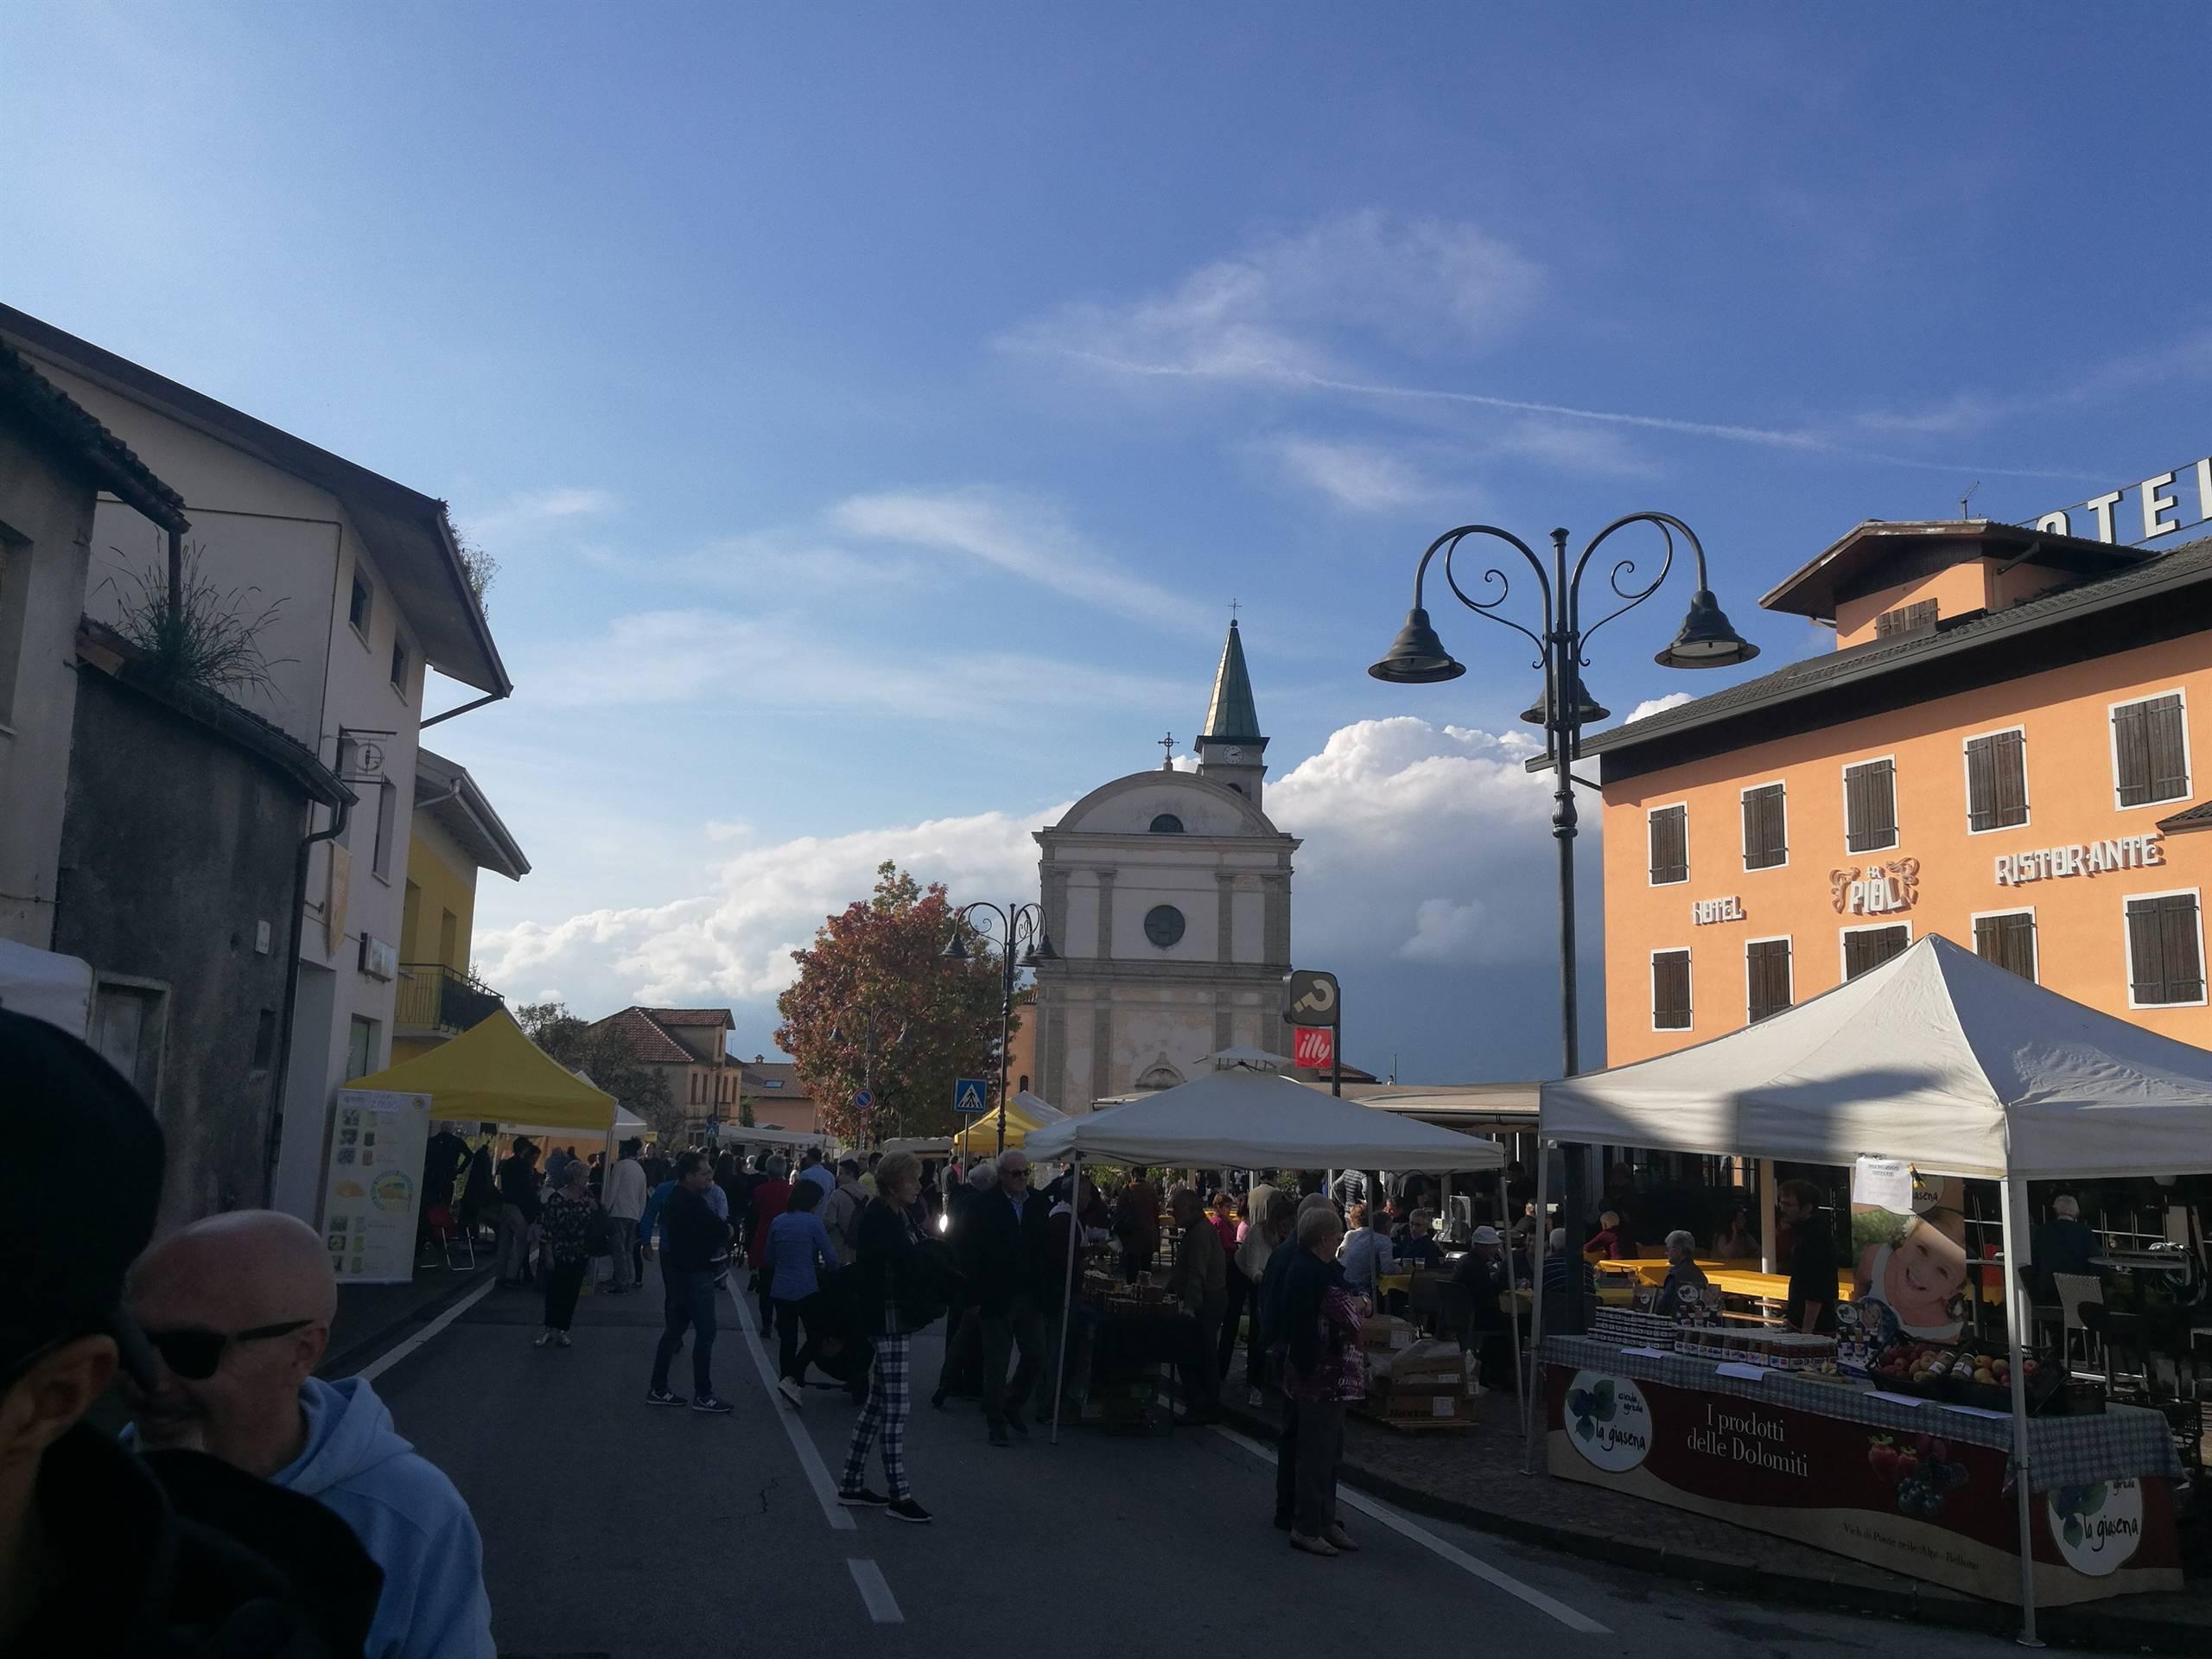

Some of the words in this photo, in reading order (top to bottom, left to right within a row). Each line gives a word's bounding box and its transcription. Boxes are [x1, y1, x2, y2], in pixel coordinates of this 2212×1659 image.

[2036, 456, 2212, 545] TEL
[1995, 832, 2160, 885] RISTORANTE
[1692, 896, 1743, 925] HOTEL
[1299, 1033, 1331, 1065] illy
[1913, 1191, 1938, 1203] asena
[1596, 1416, 1605, 1441] la
[1601, 1425, 1646, 1452] giasena
[1707, 1403, 1713, 1427] I
[1718, 1411, 1784, 1442] prodotti
[1687, 1427, 1727, 1457] delle
[1732, 1436, 1808, 1478] Dolomiti
[2083, 1514, 2093, 1539] la
[2091, 1515, 2139, 1552] giasena
